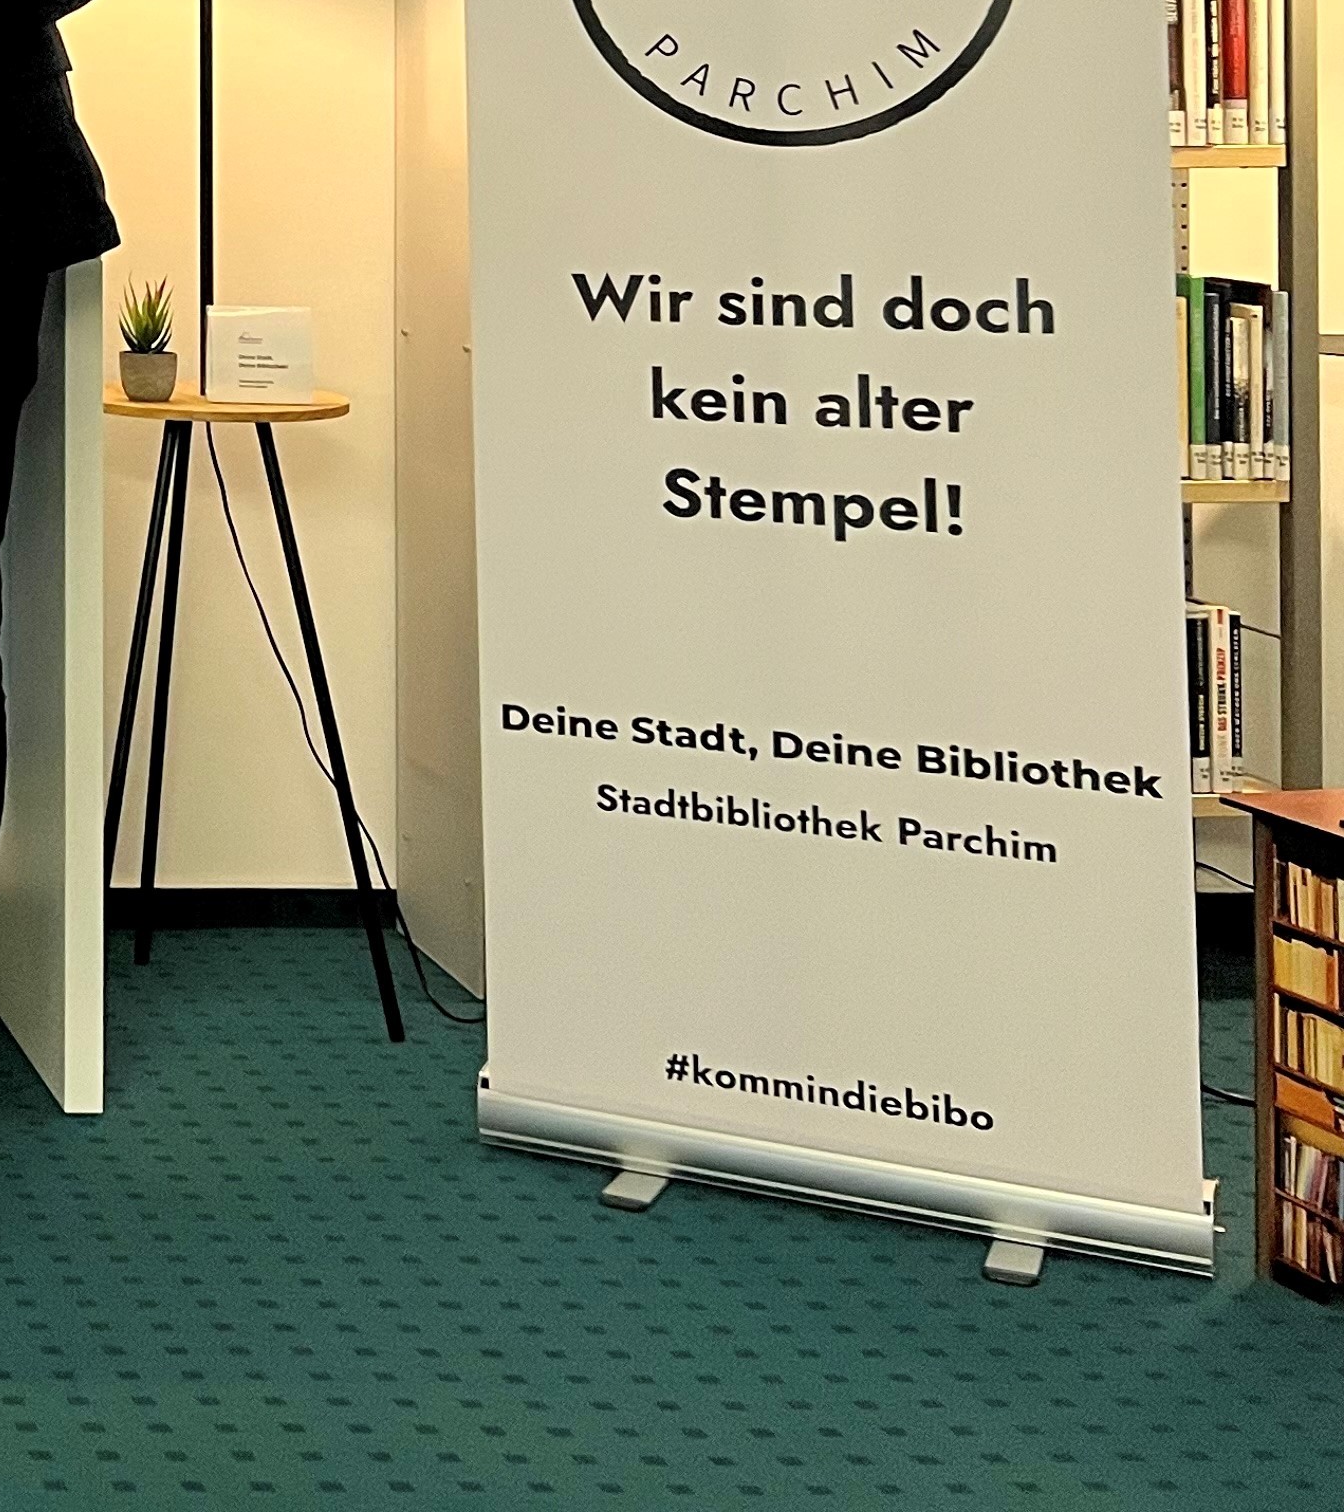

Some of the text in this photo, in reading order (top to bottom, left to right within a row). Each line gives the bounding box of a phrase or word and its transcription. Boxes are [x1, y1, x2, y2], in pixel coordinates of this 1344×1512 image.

[644, 29, 941, 116] PARCHIM
[571, 273, 1055, 334] Wir sind doch
[651, 365, 974, 433] kein alter
[662, 467, 963, 542] Stempel!
[500, 703, 619, 741] Deine
[630, 716, 759, 761] Stadt,
[771, 730, 902, 770] Deine
[917, 744, 1164, 799] Bibliothek
[596, 784, 1058, 864] Stadtbibliothek Parchim
[664, 1053, 994, 1131] #kommindiebibo
